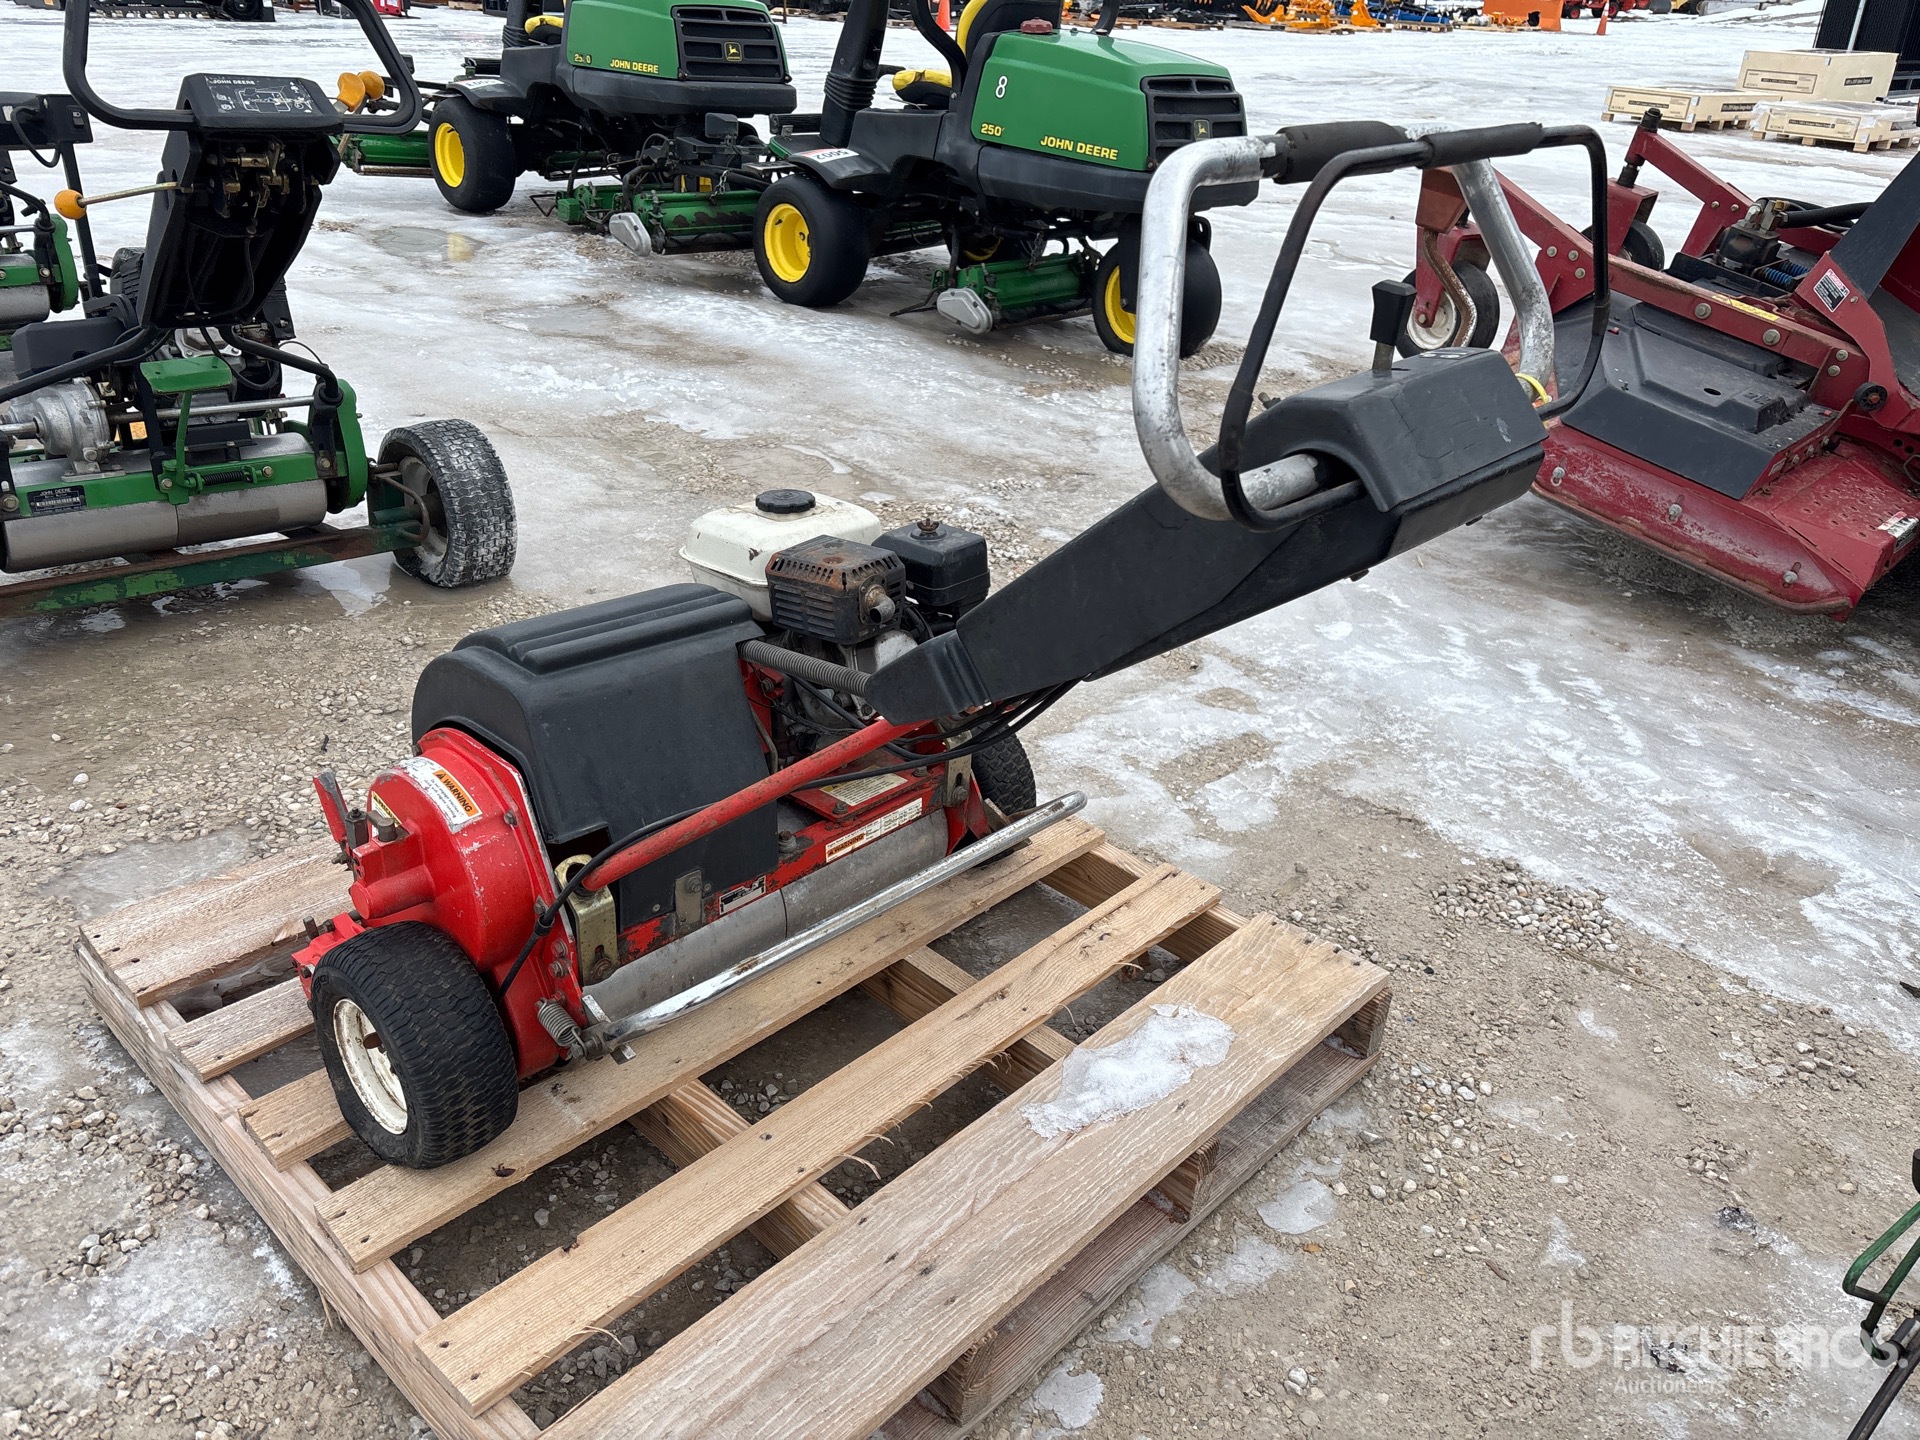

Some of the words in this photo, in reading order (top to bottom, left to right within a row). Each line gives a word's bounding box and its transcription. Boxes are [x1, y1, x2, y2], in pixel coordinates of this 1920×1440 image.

[609, 59, 631, 70] JOHN
[632, 62, 659, 74] DEERE
[995, 75, 1008, 98] 8
[1040, 135, 1074, 152] JOHN
[1076, 142, 1119, 161] DEERE
[443, 778, 473, 813] WARNING
